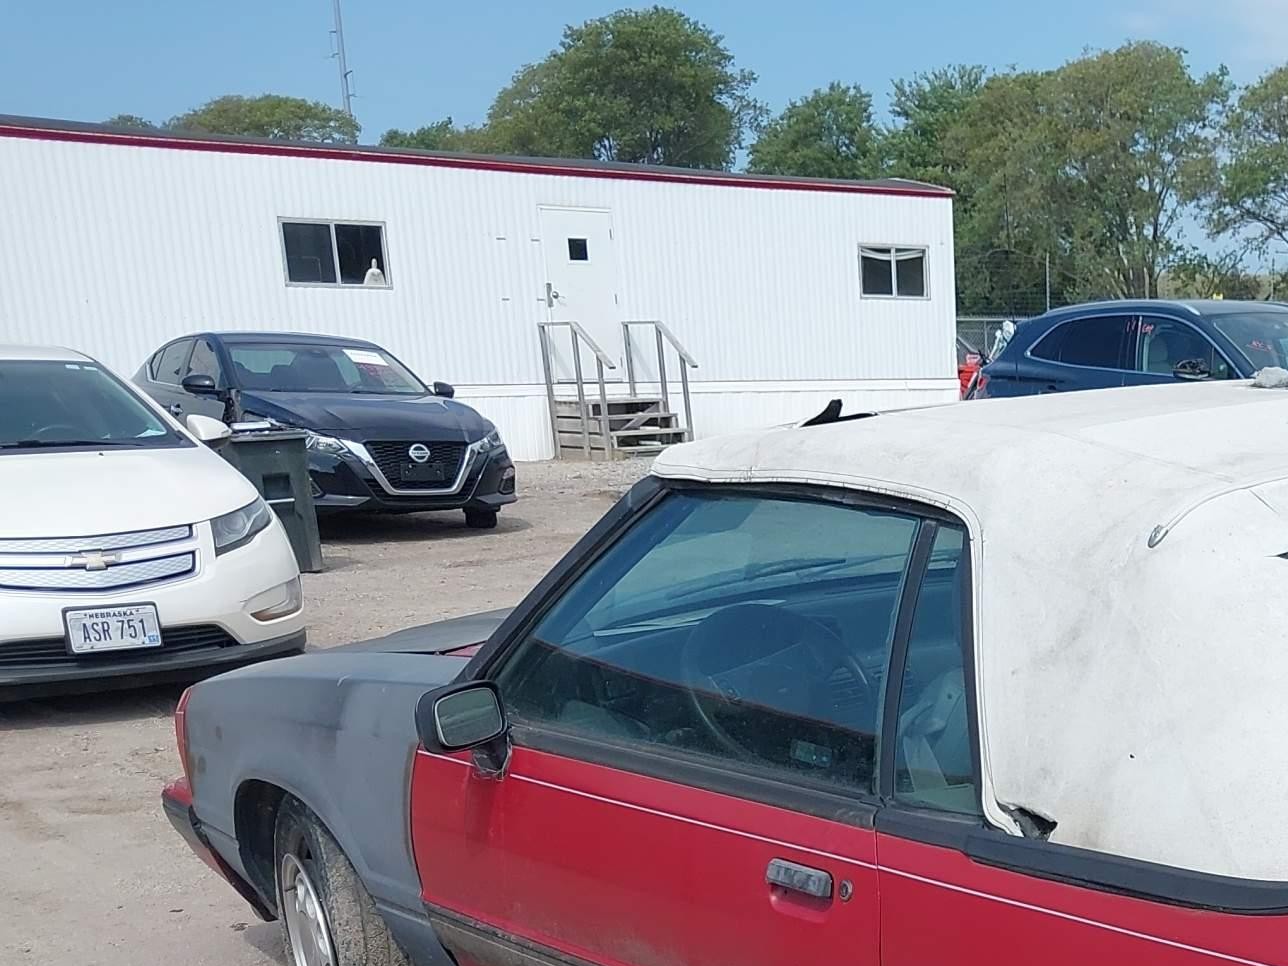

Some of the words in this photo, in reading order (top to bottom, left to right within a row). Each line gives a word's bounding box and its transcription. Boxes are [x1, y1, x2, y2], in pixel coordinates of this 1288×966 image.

[89, 610, 134, 619] NEBRASKA
[82, 621, 112, 643] ASR
[116, 618, 147, 640] 751
